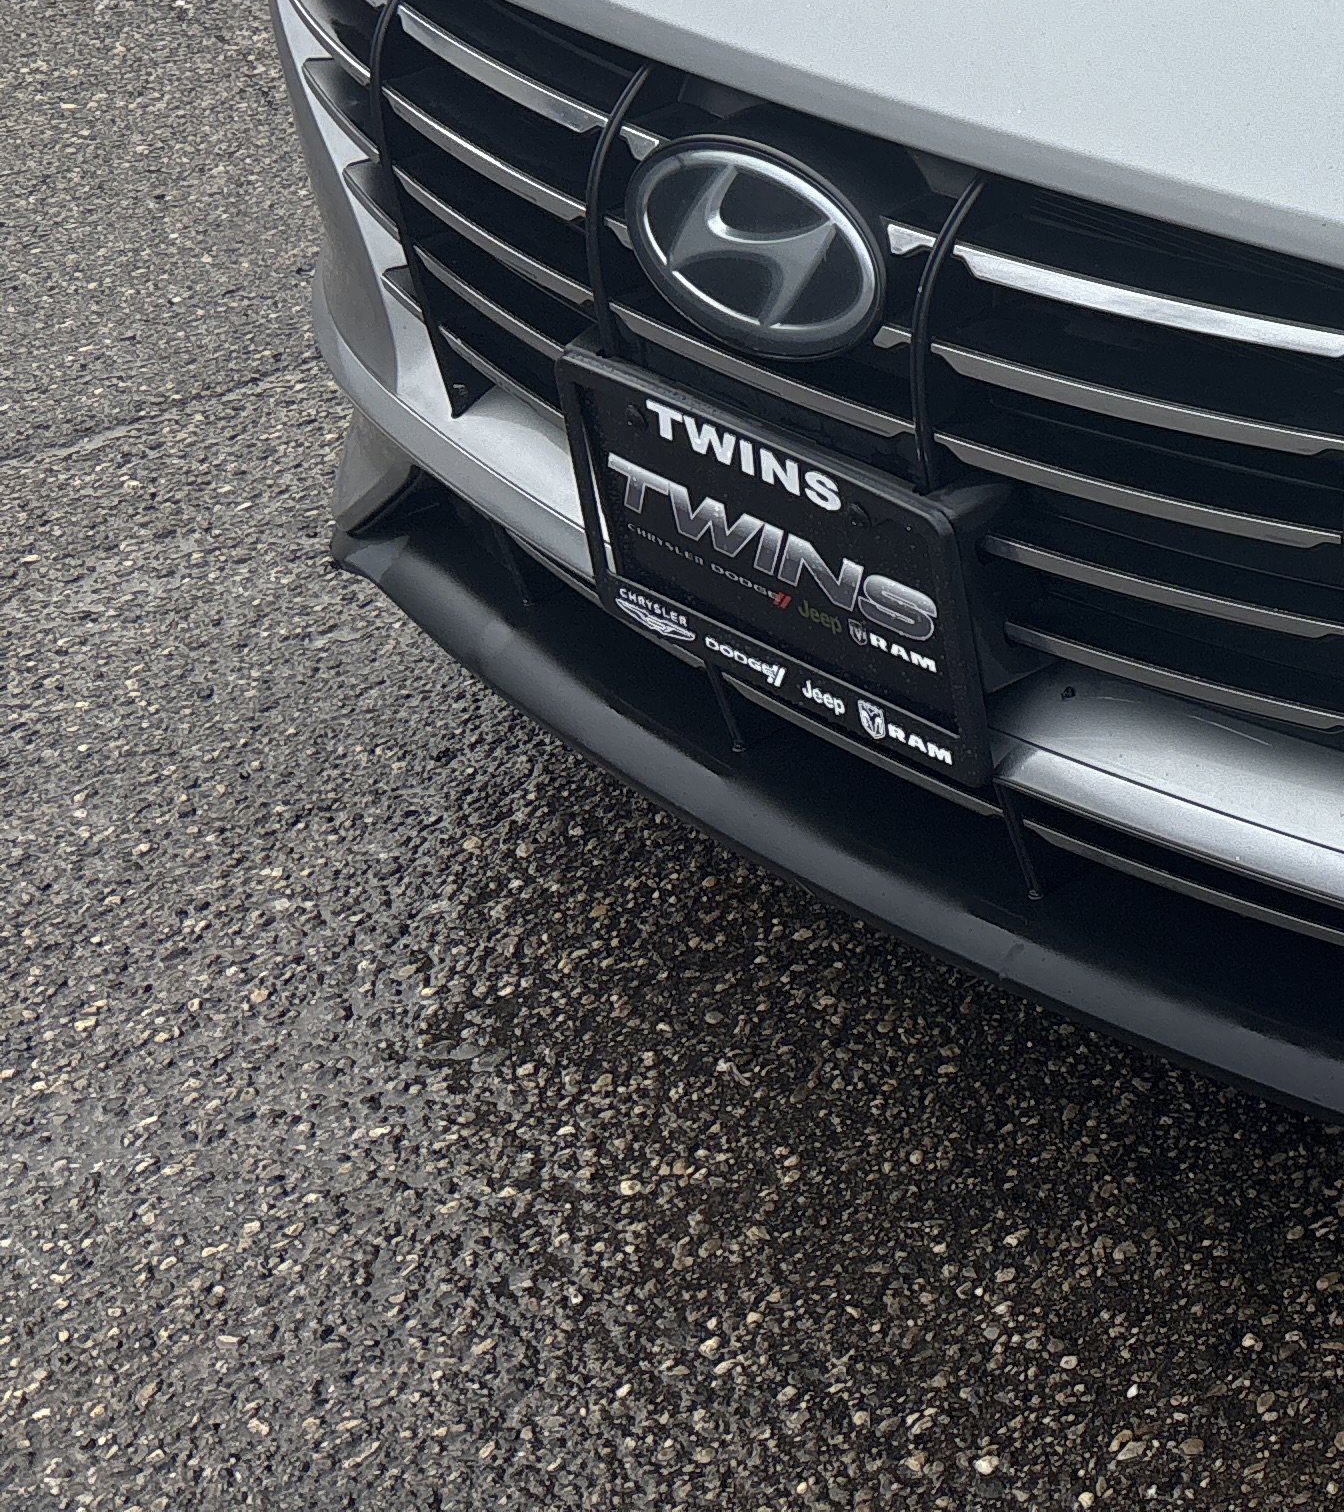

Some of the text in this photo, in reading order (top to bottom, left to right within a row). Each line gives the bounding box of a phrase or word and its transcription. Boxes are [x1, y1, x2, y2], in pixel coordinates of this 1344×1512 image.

[645, 399, 842, 511] TWINS
[607, 452, 938, 642] TWINS
[627, 522, 704, 566] CHRYSLER
[798, 600, 843, 634] Jeep
[869, 632, 937, 673] RAM
[618, 588, 688, 628] CHRYSLER
[801, 680, 846, 716] Jeep
[887, 723, 953, 766] RAM
